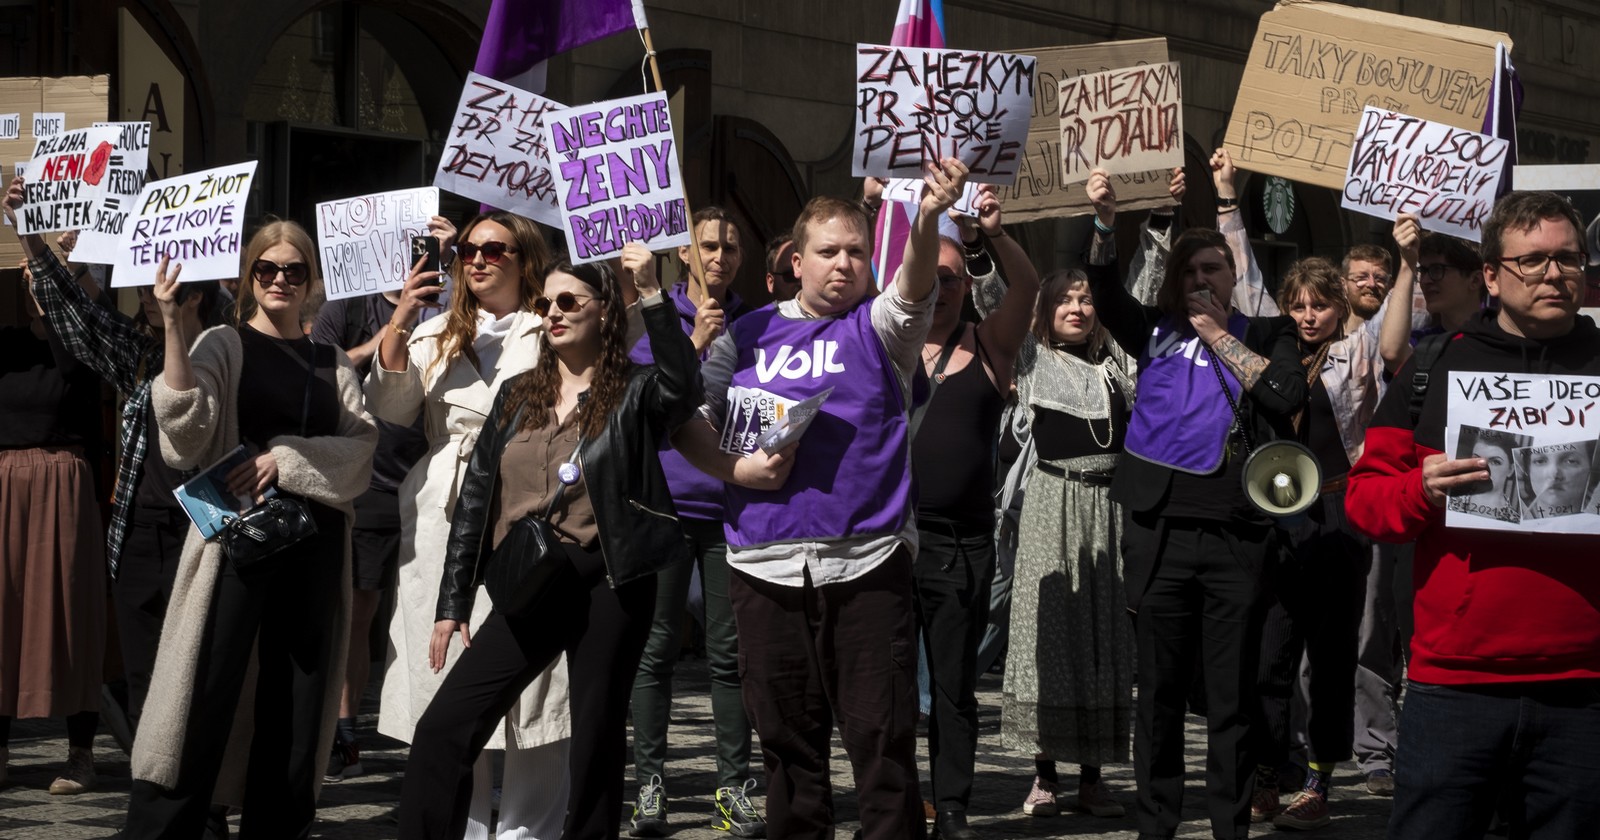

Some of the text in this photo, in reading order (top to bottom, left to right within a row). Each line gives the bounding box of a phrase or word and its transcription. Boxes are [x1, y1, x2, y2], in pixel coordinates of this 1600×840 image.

[857, 46, 921, 87] ZA
[922, 50, 1036, 97] HEZKÝM
[1263, 32, 1494, 120] TAKY BOJUJEM
[466, 81, 519, 123] ZA
[857, 86, 905, 127] PR
[912, 84, 998, 121] JSOU
[1060, 78, 1093, 119] ZA
[457, 112, 502, 148] PR
[550, 99, 671, 154] NECHTE
[1063, 116, 1091, 174] PR
[1241, 111, 1355, 172] POT
[1424, 127, 1507, 167] JSOU
[140, 172, 250, 217] PRO ŽIVOT
[558, 139, 673, 212] ŽENY
[24, 200, 93, 233] MAJETEK
[131, 200, 236, 242] RIZIKOVĚ
[321, 195, 387, 239] MOJE
[568, 198, 689, 259] ROZHODOVAT
[129, 227, 240, 267] TĚHOTNÝCH
[325, 240, 378, 295] MOJE
[753, 339, 846, 384] Volt
[1456, 373, 1532, 402] VAŠE
[743, 431, 758, 450] Volt
